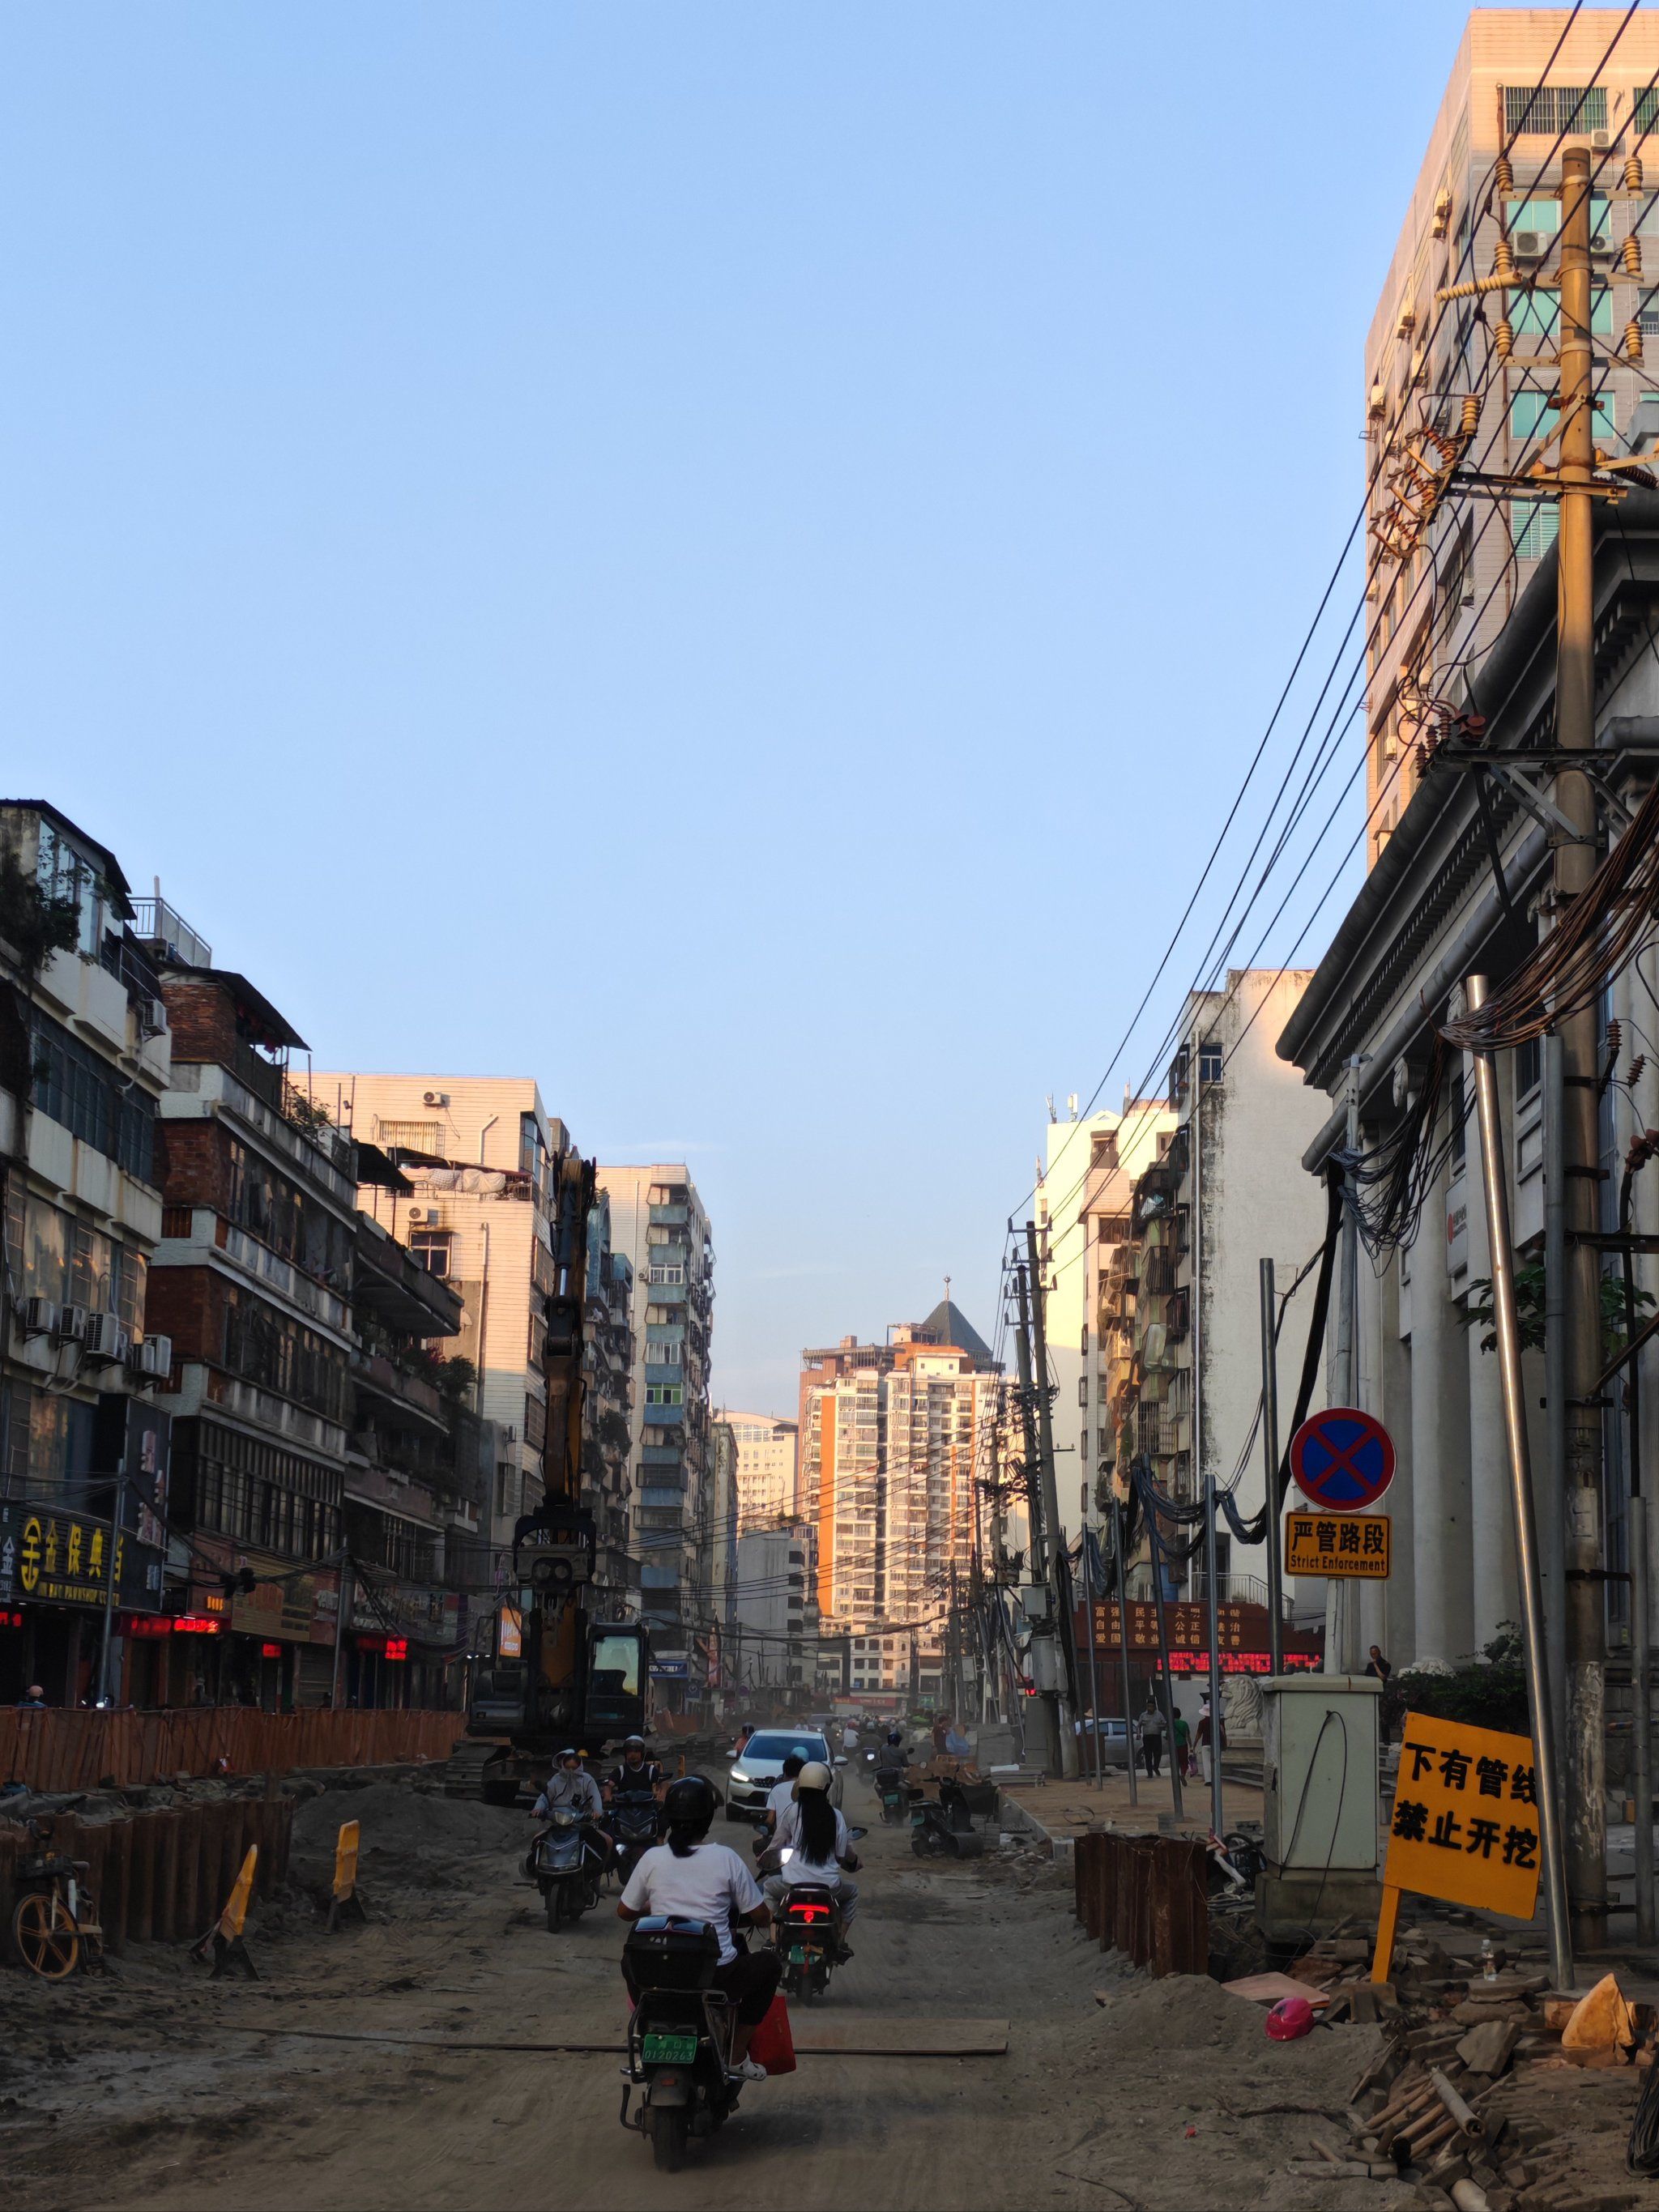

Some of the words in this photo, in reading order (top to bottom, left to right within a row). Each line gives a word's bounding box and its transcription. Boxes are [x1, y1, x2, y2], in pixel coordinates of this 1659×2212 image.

[1292, 1521, 1384, 1554] 严管路段
[1290, 1554, 1320, 1569] Strict
[1322, 1556, 1385, 1571] Enforcement
[1095, 1606, 1120, 1617] 富强
[1135, 1607, 1158, 1618] 民主
[1175, 1608, 1201, 1618] 文明
[1096, 1620, 1121, 1630] 自由
[1135, 1620, 1158, 1631] 平等
[1175, 1621, 1201, 1631] 公正
[1095, 1633, 1121, 1643] 爱国
[1135, 1633, 1159, 1644] 敬业
[1175, 1634, 1201, 1644] 诚信
[1405, 1741, 1537, 1807] 下有管线
[1392, 1800, 1538, 1869] 禁止开挖
